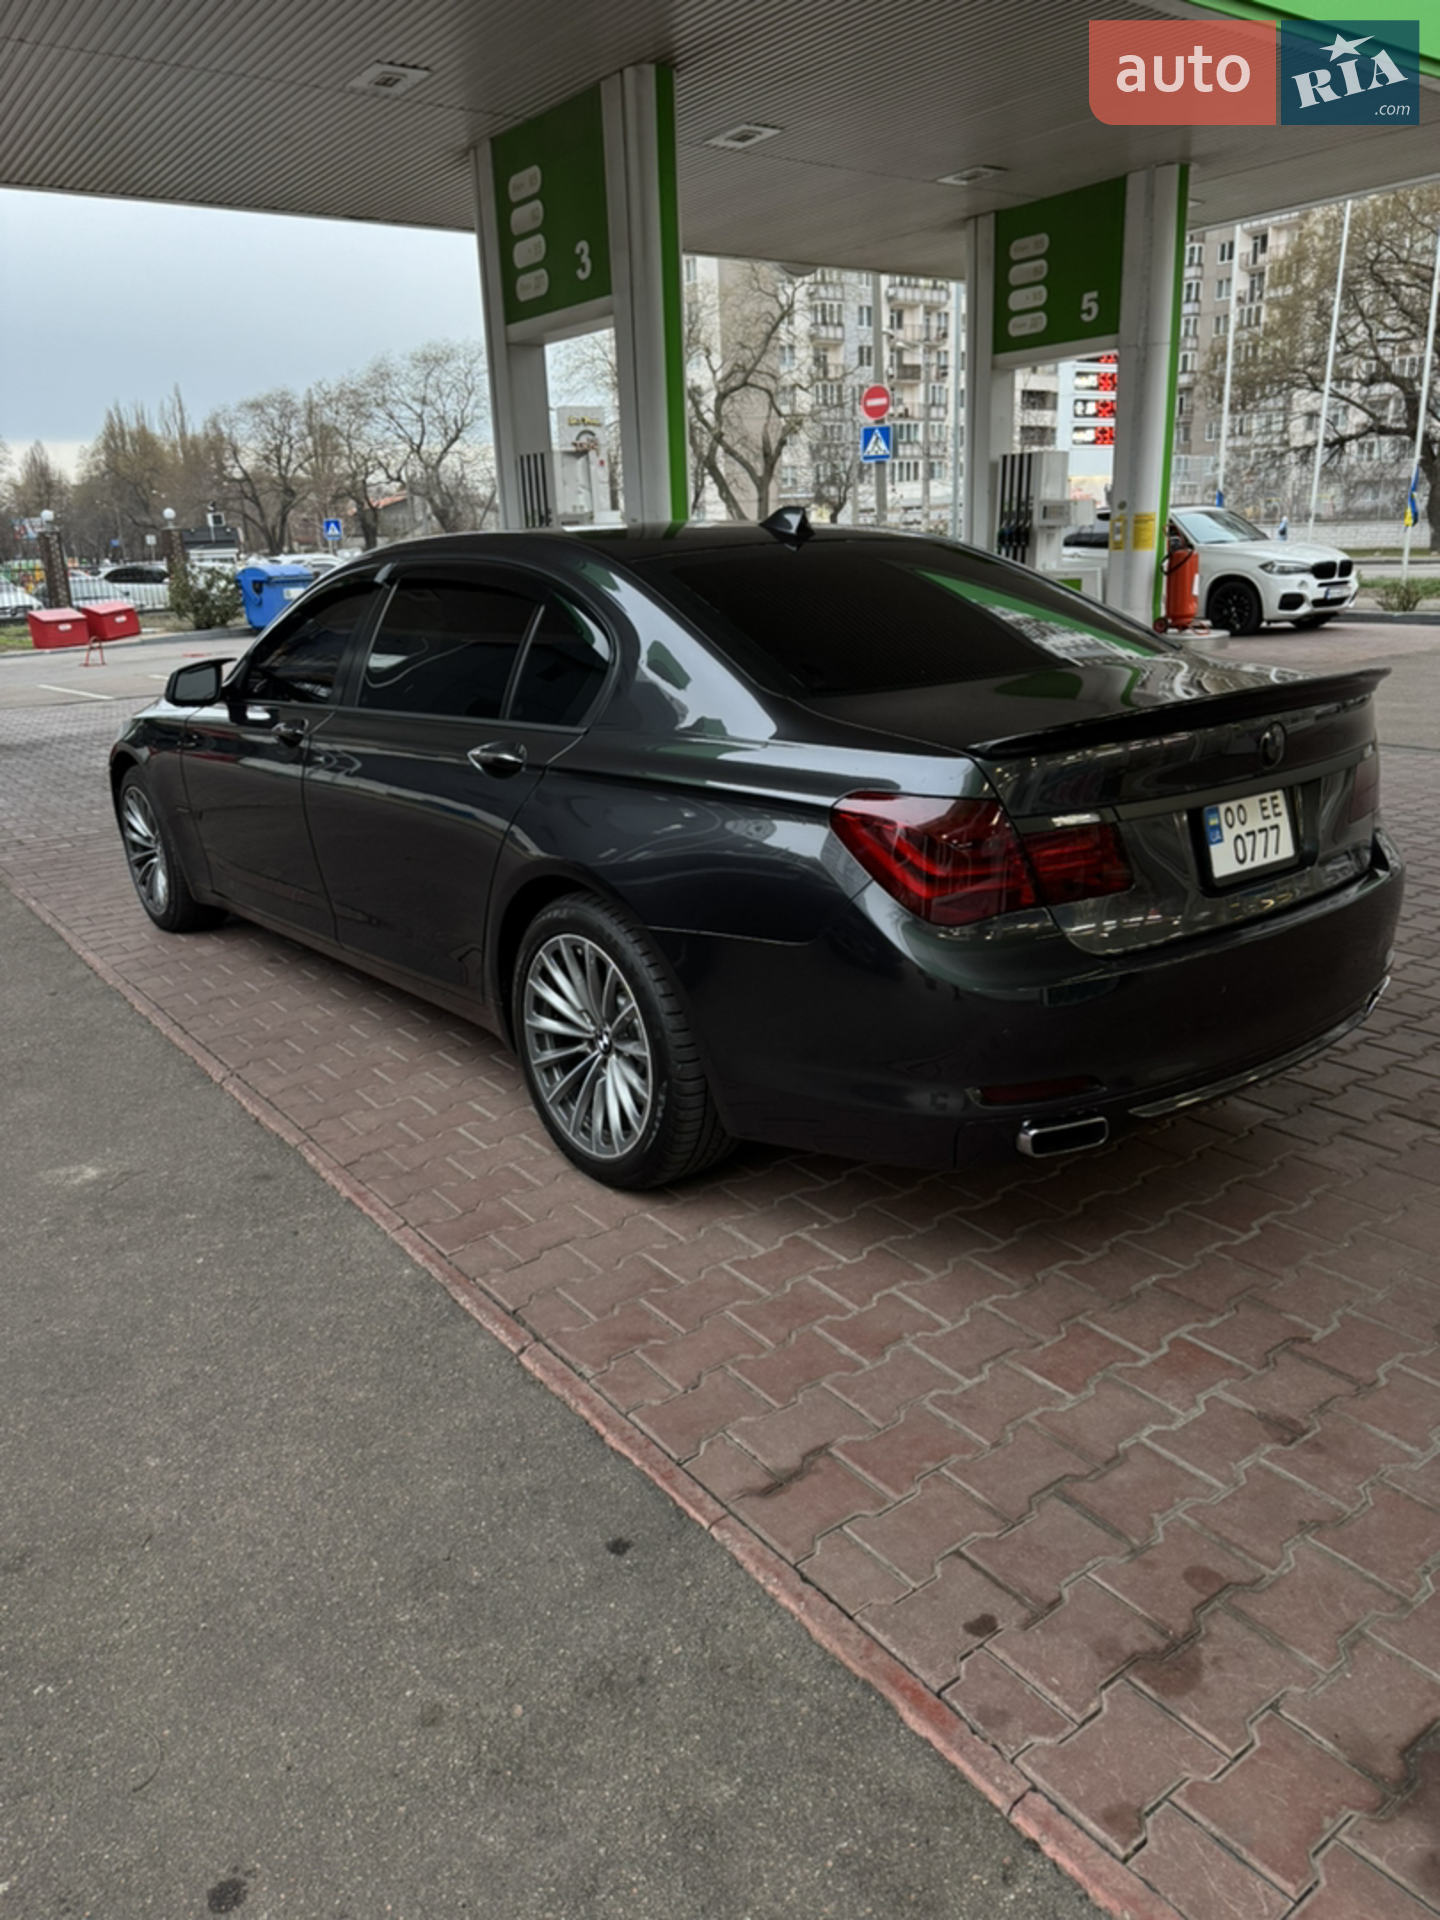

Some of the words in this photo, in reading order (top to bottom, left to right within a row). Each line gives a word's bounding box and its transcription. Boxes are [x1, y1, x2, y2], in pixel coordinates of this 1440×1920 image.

[575, 240, 591, 280] 3
[1080, 291, 1098, 322] 5
[1259, 795, 1282, 820] EE
[1234, 824, 1280, 865] 0777
